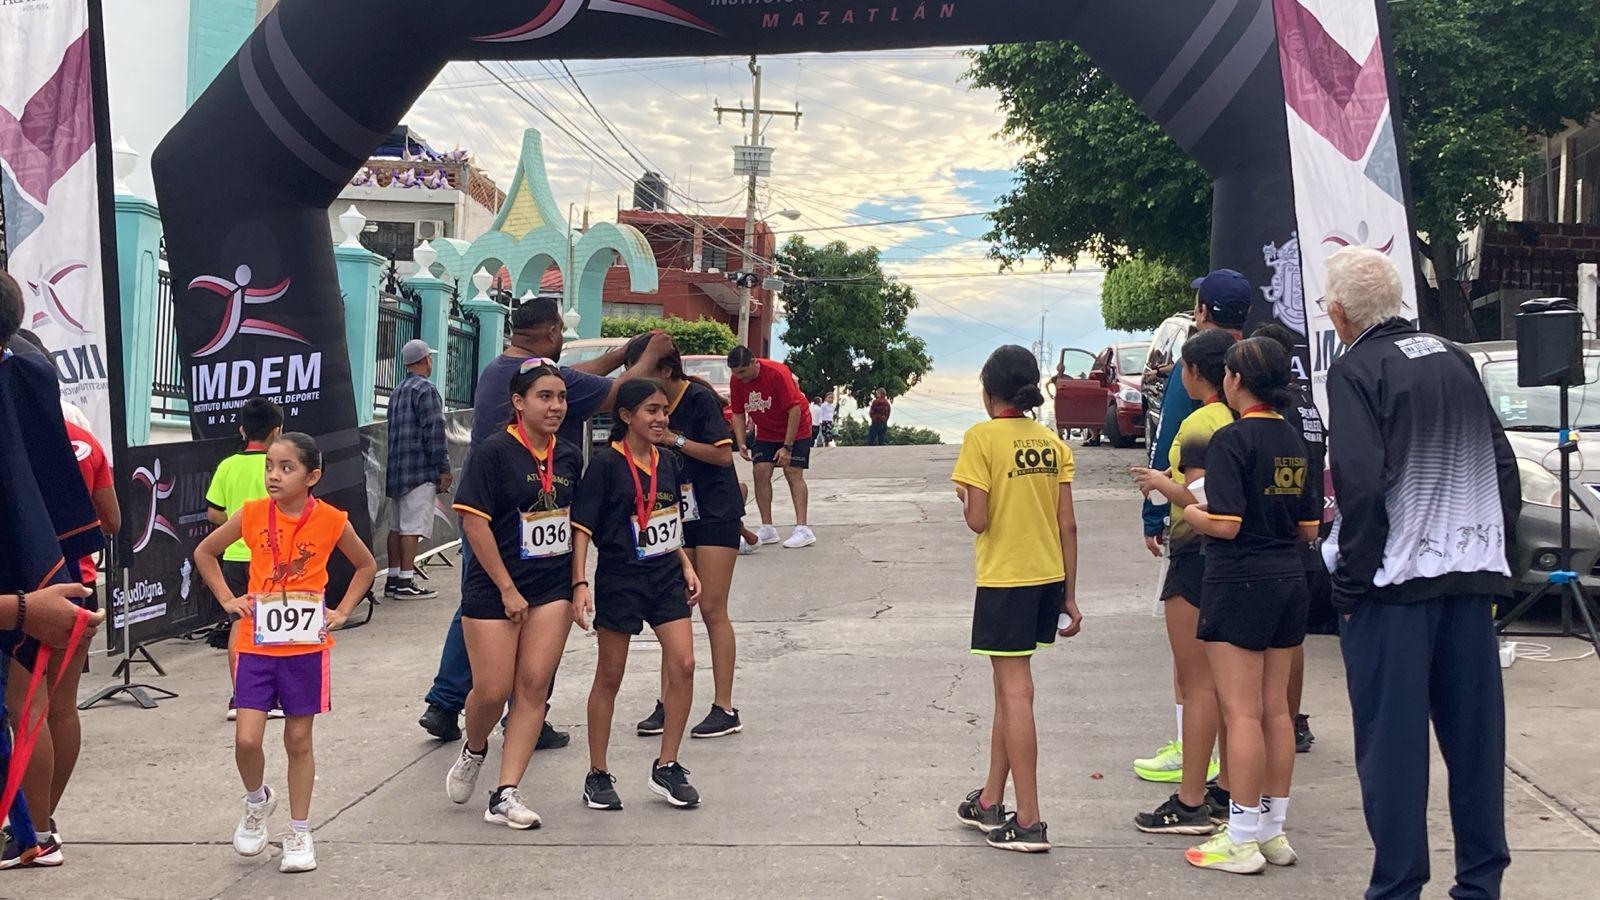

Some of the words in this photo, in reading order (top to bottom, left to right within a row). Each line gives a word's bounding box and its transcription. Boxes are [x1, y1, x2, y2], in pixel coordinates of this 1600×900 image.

[762, 1, 955, 28] MAZATLÁN
[191, 352, 322, 402] IMDEM
[221, 399, 249, 410] MUNIC
[285, 391, 320, 404] DEPORTE
[1013, 439, 1054, 449] ATLETISM
[1014, 447, 1058, 469] COCI
[526, 472, 570, 487] ATLSMO
[531, 521, 567, 547] 036
[646, 517, 678, 547] 037
[112, 579, 164, 607] SaudDigna
[266, 607, 316, 632] 097
